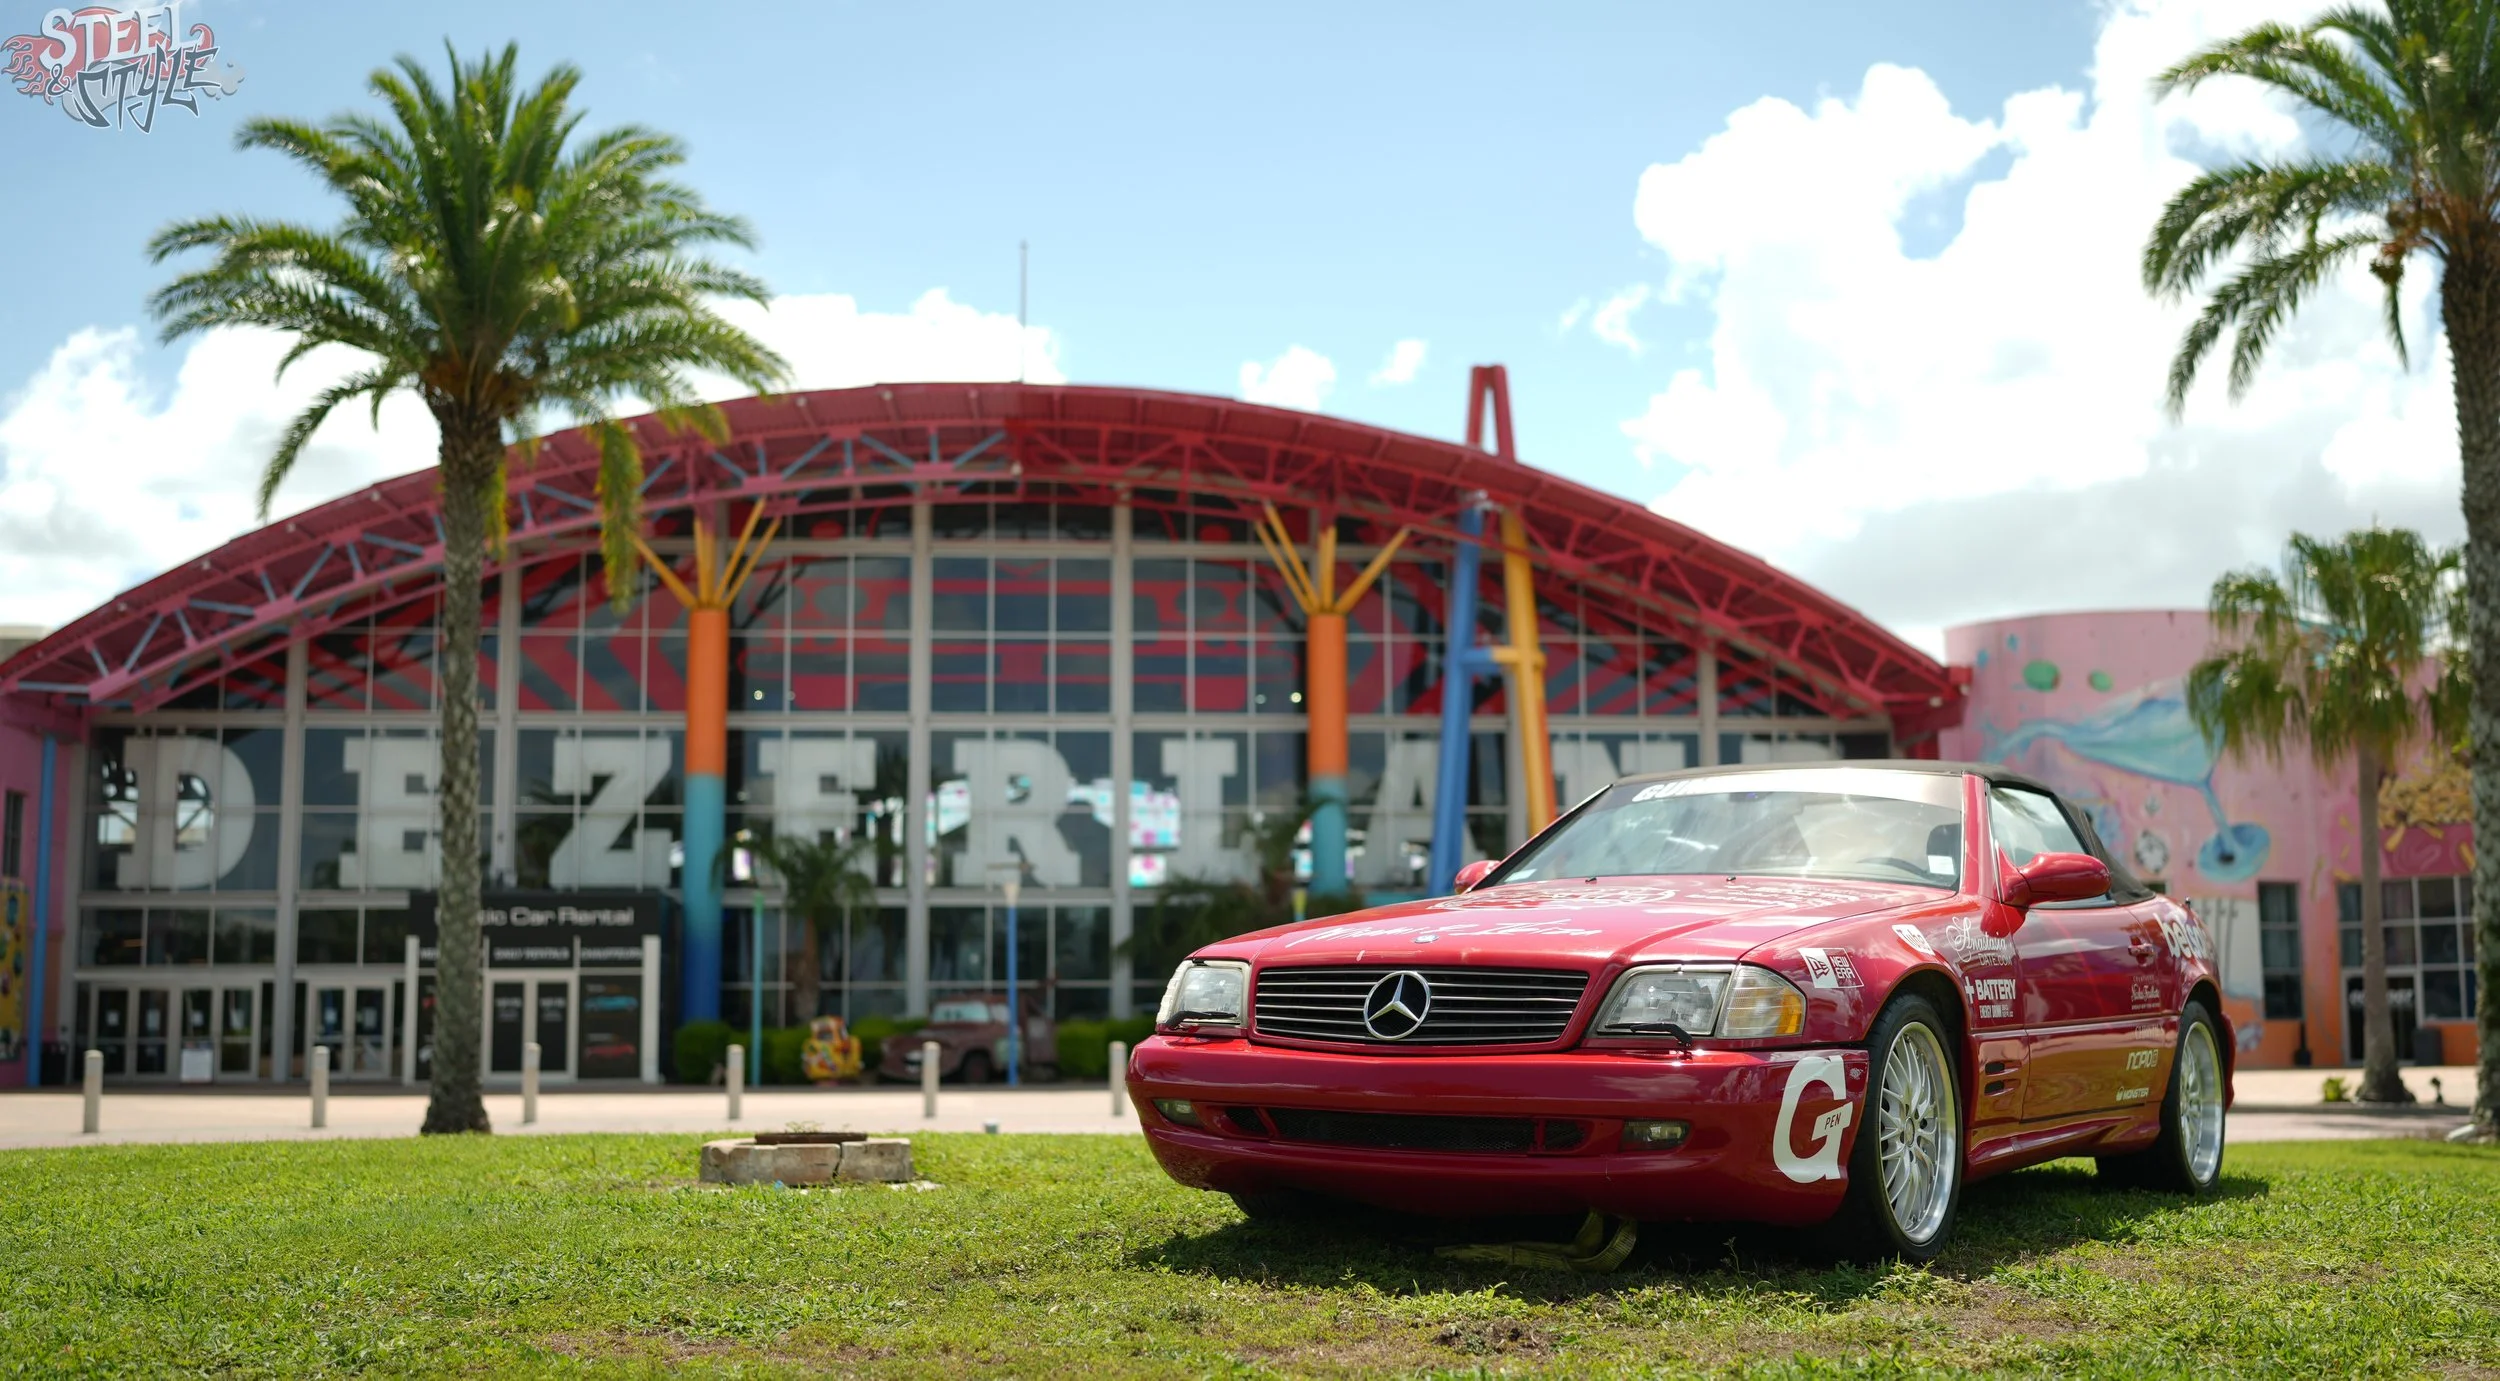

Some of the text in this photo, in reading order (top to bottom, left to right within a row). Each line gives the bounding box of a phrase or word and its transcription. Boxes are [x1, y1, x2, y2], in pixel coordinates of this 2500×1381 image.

[509, 907, 554, 926] Car
[557, 907, 635, 926] Rental
[1946, 916, 2007, 962] Anastasia
[1830, 956, 1850, 967] NEW
[1835, 967, 1855, 979] ERA
[1975, 979, 2016, 1000] BATTERY
[2123, 1087, 2150, 1100] MONSTER
[1773, 1055, 1853, 1183] G
[1825, 1112, 1842, 1130] PEN
